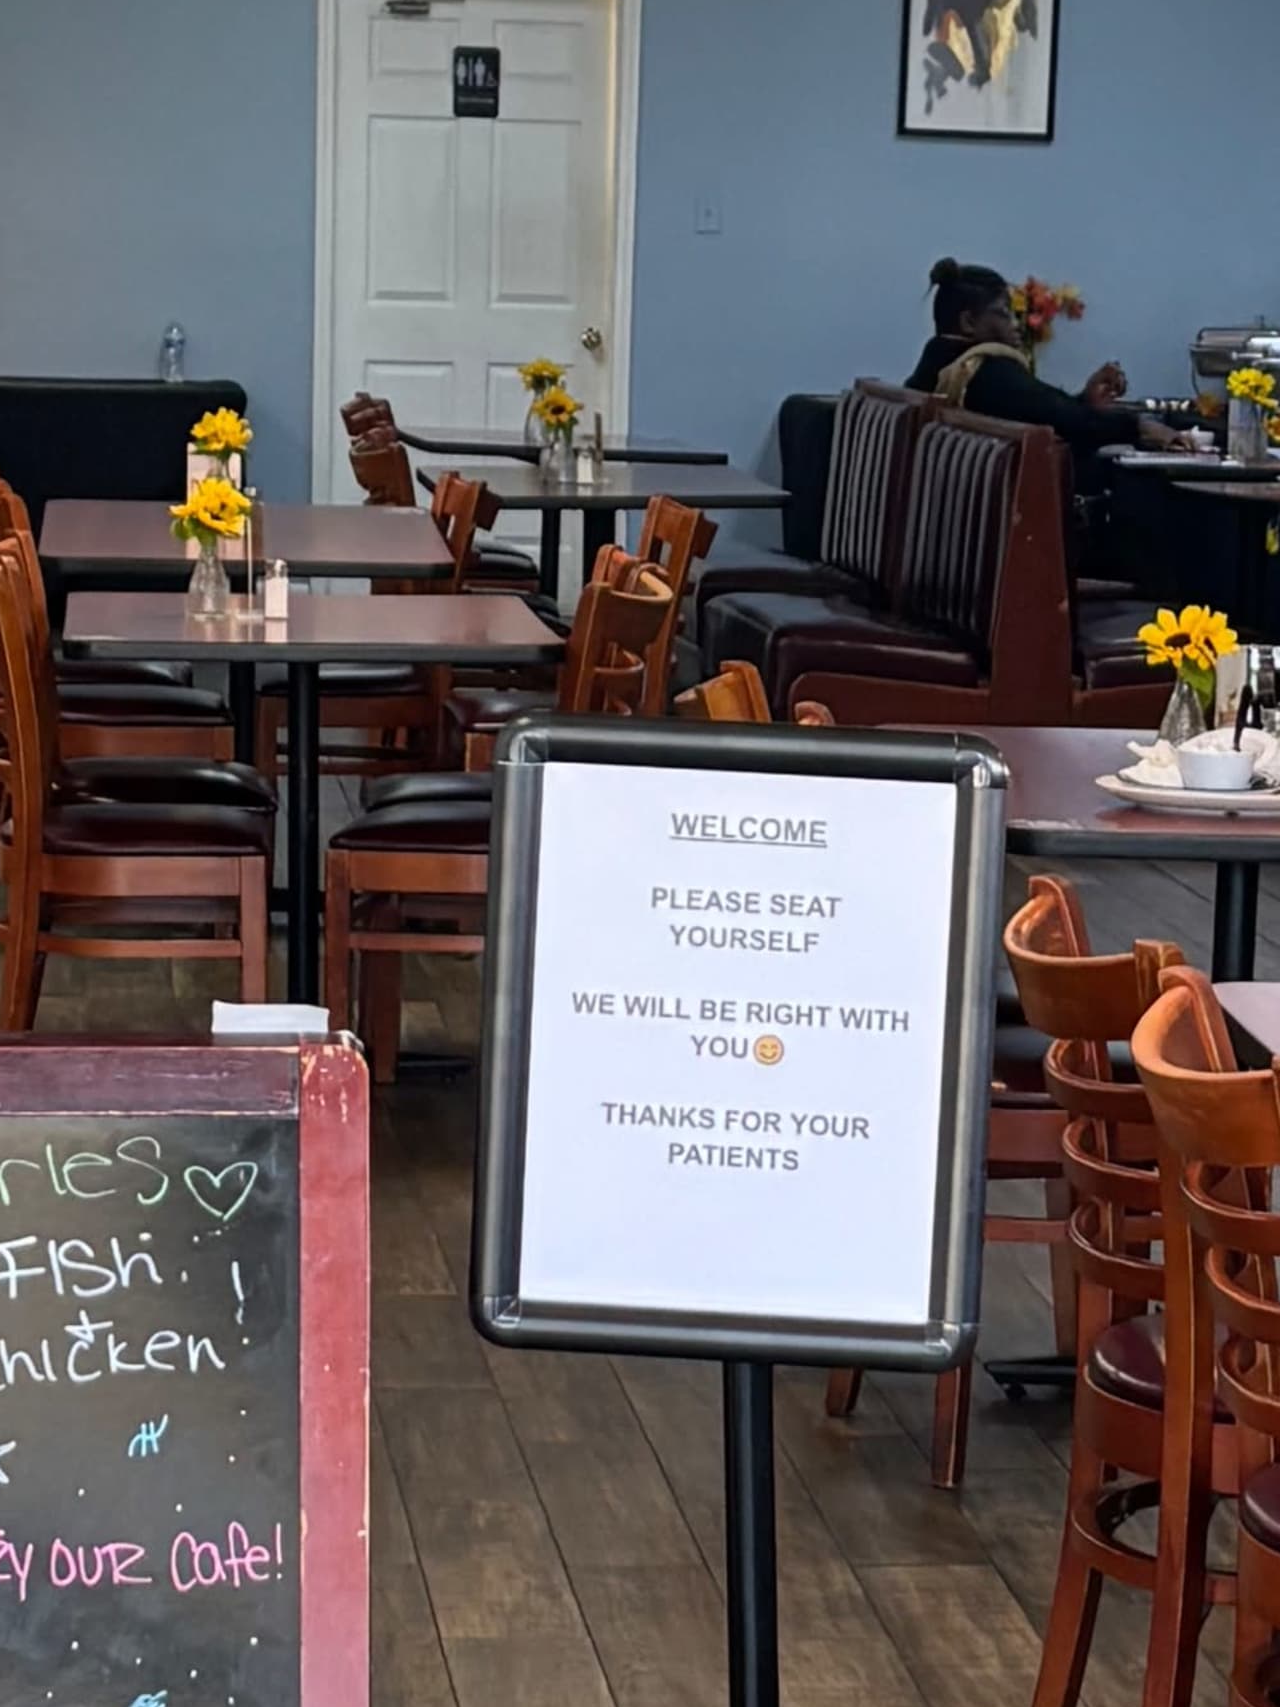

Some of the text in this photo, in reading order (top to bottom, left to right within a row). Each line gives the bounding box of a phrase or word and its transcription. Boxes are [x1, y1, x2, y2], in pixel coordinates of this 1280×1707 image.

[670, 811, 828, 848] WELCOME
[651, 887, 842, 919] PLEASE SEAT
[669, 925, 819, 953] YOURSELF
[571, 993, 910, 1032] WE WILL BE RIGHT WITH
[690, 1035, 748, 1059] YOU
[601, 1102, 870, 1139] THANKS FOR YOUR
[667, 1143, 799, 1171] PATIENTS
